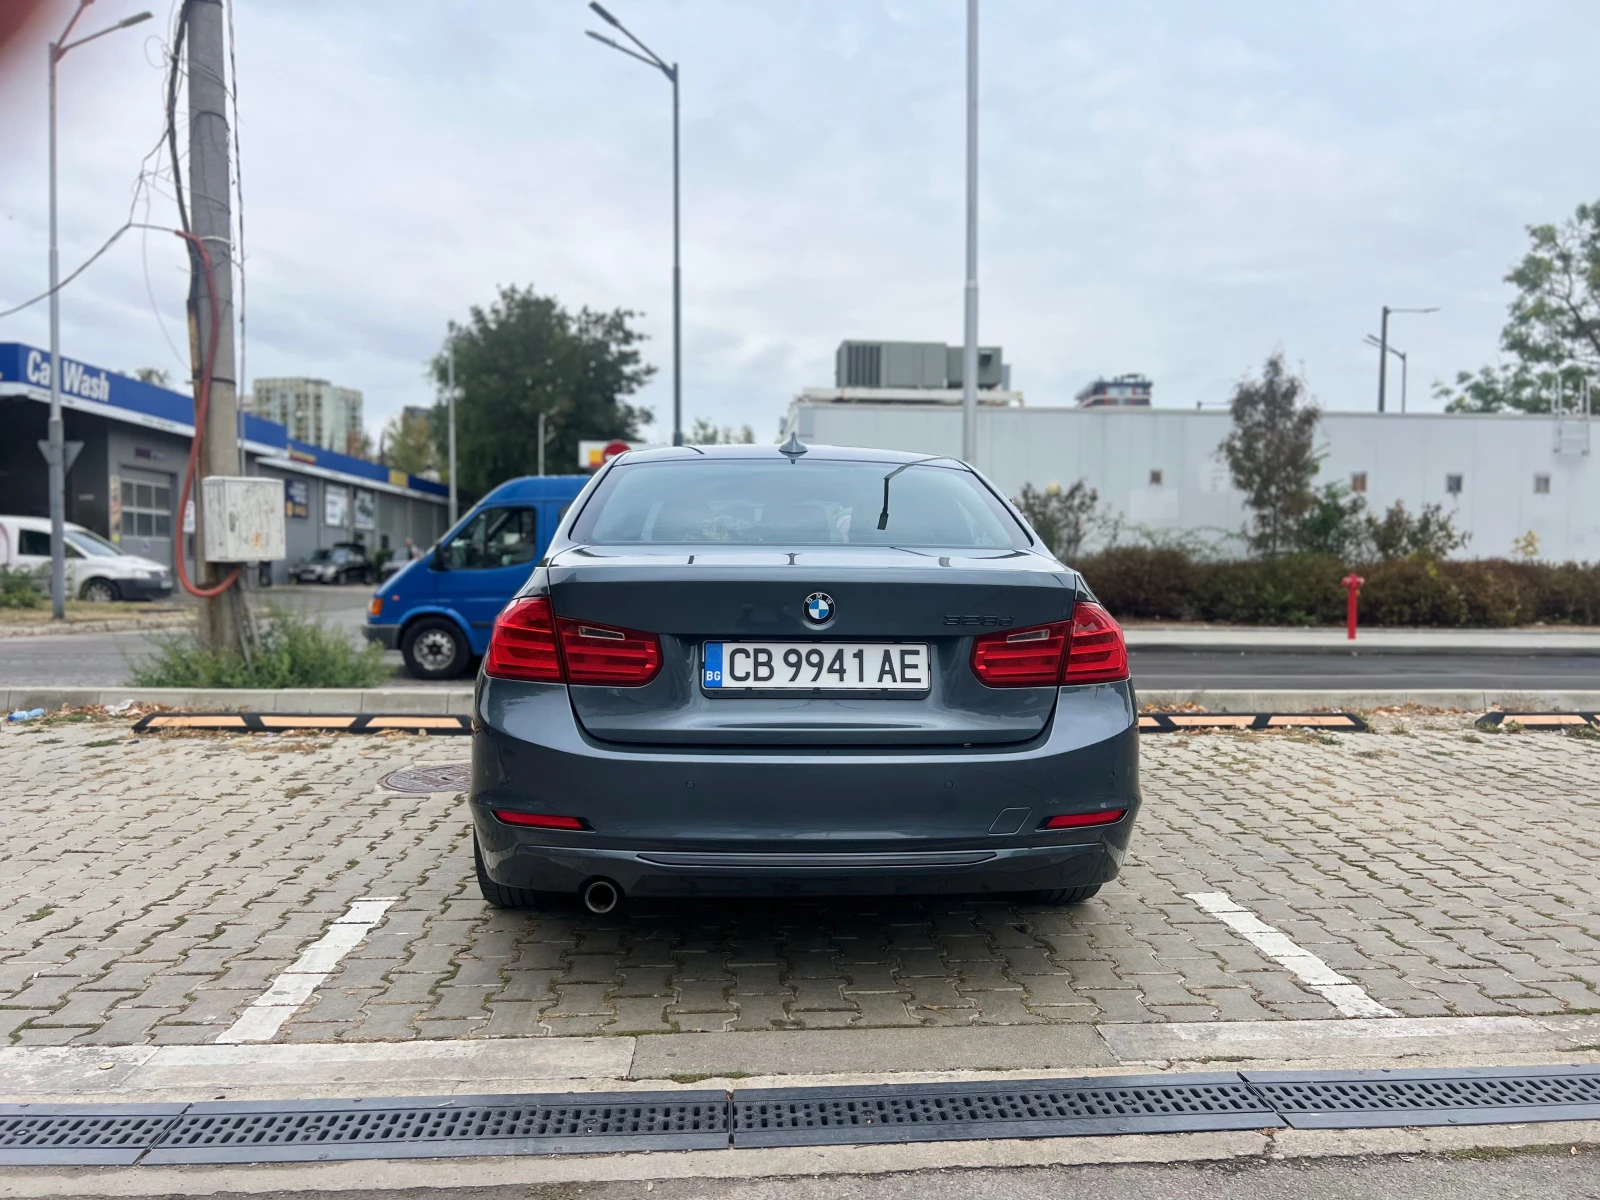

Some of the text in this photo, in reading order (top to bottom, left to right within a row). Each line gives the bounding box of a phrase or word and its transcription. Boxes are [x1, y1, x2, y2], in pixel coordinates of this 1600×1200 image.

[27, 350, 110, 402] Ca Wash
[805, 593, 833, 604] BMW
[706, 671, 721, 681] BG
[729, 648, 922, 683] CB 9941 AE
